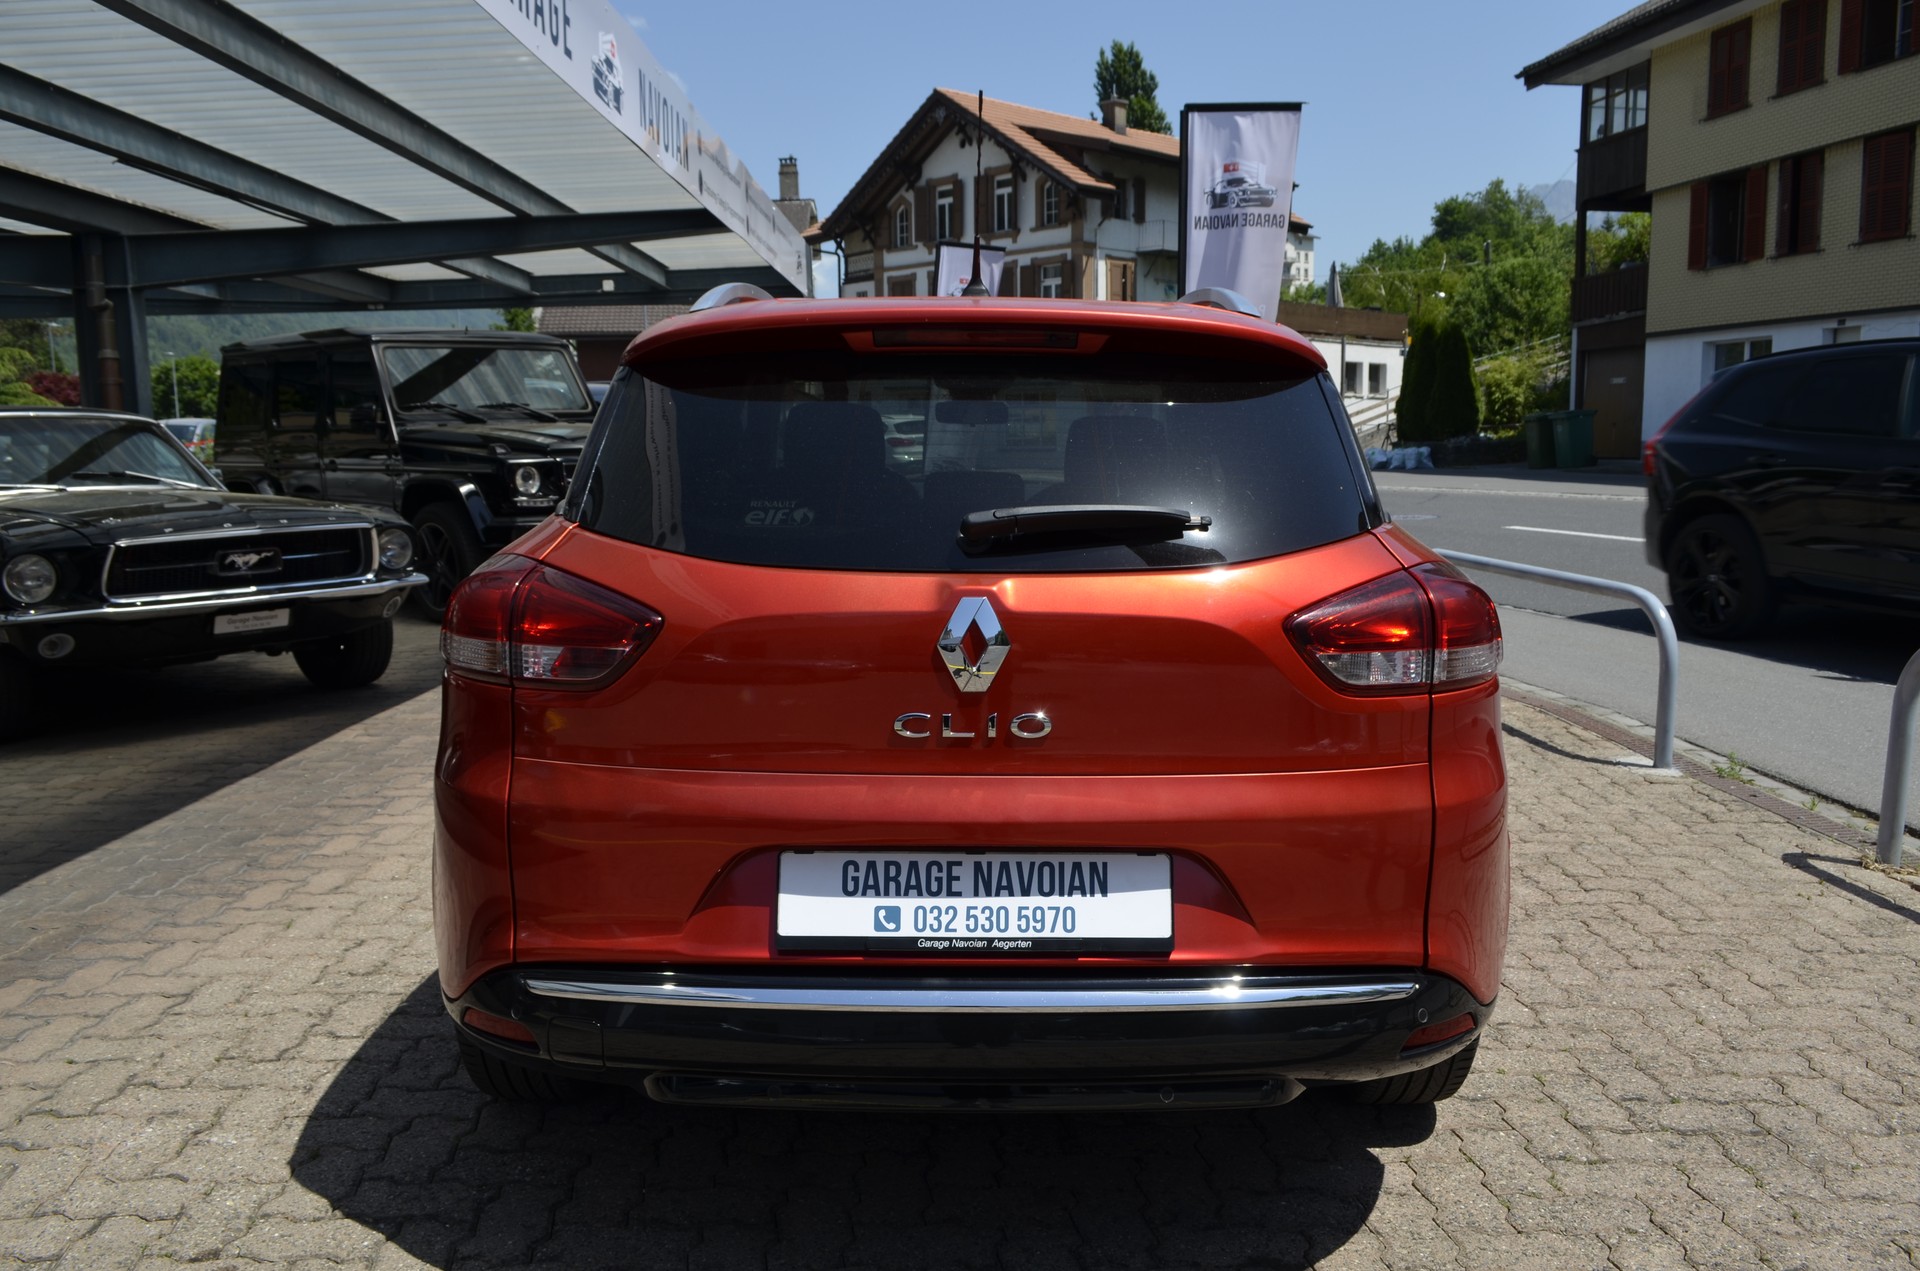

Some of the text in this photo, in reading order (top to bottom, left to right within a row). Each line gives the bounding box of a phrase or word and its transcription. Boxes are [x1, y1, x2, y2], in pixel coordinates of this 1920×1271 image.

[750, 500, 798, 508] RENAULT
[893, 712, 1052, 739] CLIO
[841, 859, 1108, 898] GARAGE NAVOIAN
[913, 905, 1076, 934] 032 530 5970
[917, 938, 1032, 950] Garage Navoian Aegerten
